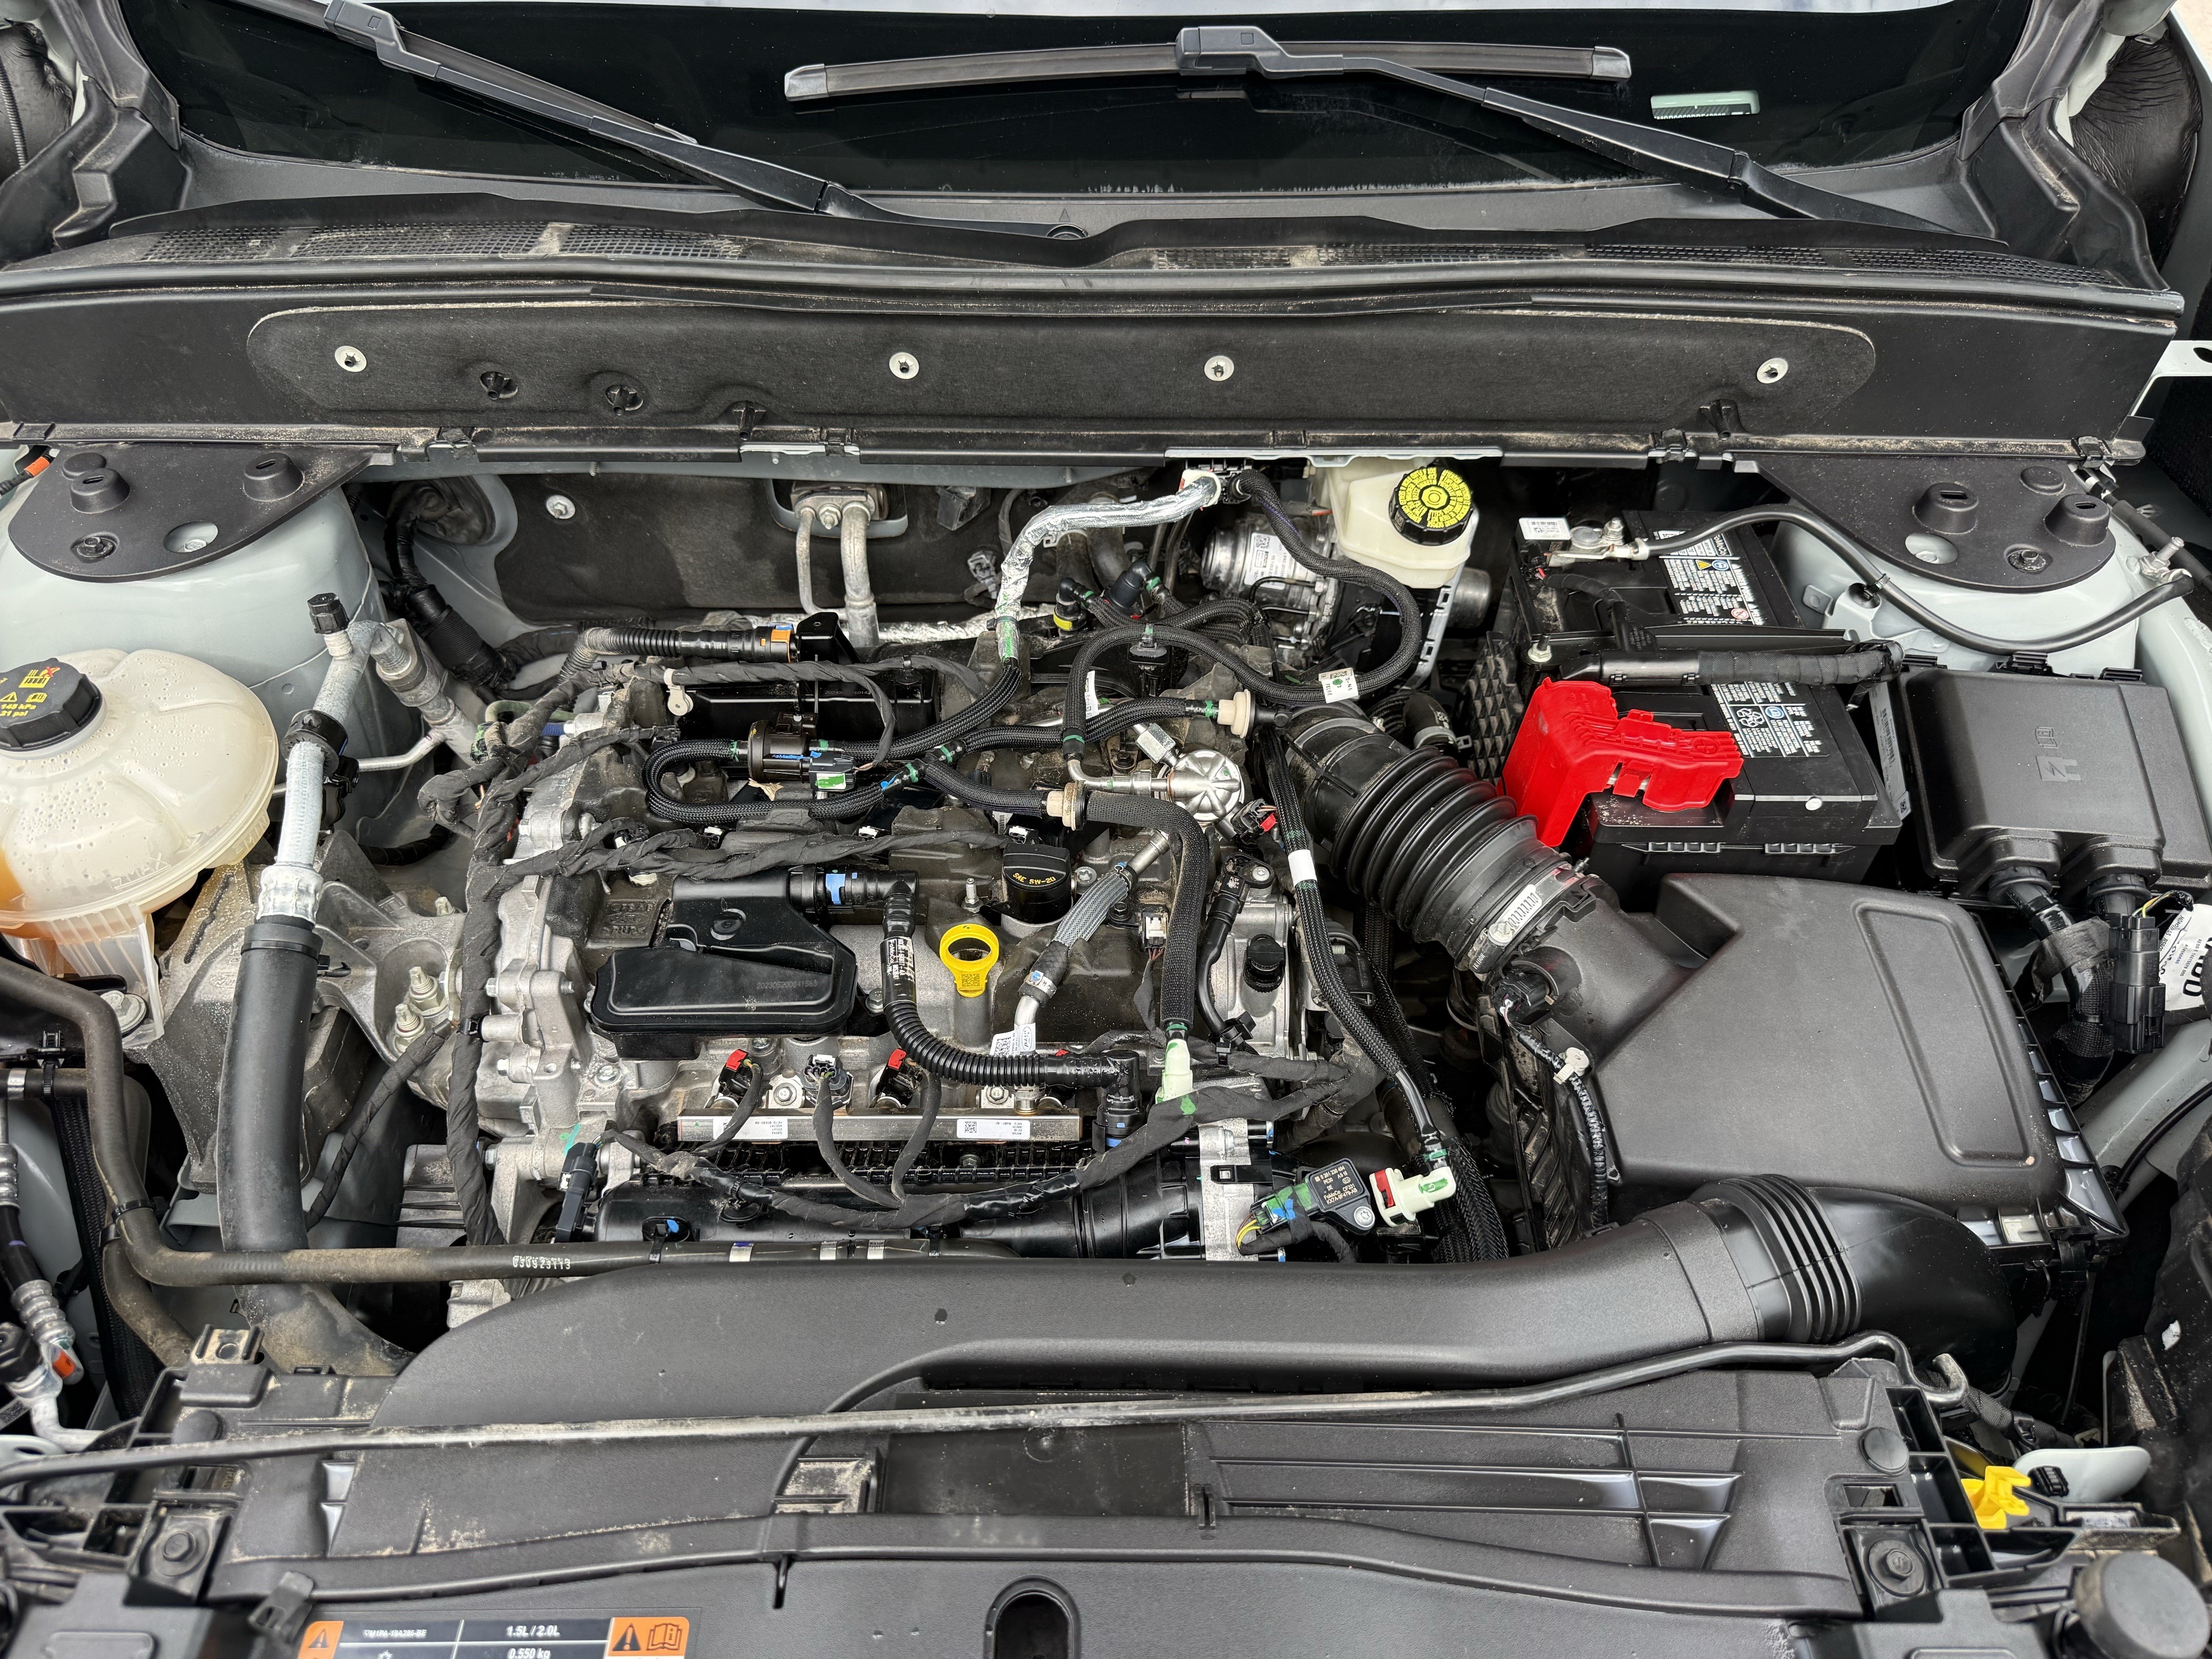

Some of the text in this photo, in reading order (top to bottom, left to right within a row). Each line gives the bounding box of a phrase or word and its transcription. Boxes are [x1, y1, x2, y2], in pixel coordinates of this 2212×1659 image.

[1013, 872, 1056, 885] SAE 5W-20
[1322, 1176, 1333, 1185] PE30
[1323, 1183, 1355, 1200] FoMoCo CF331
[506, 1625, 529, 1637] 1.5L
[538, 1625, 560, 1637] 2.0L
[507, 1648, 551, 1659] 0.550 kg
